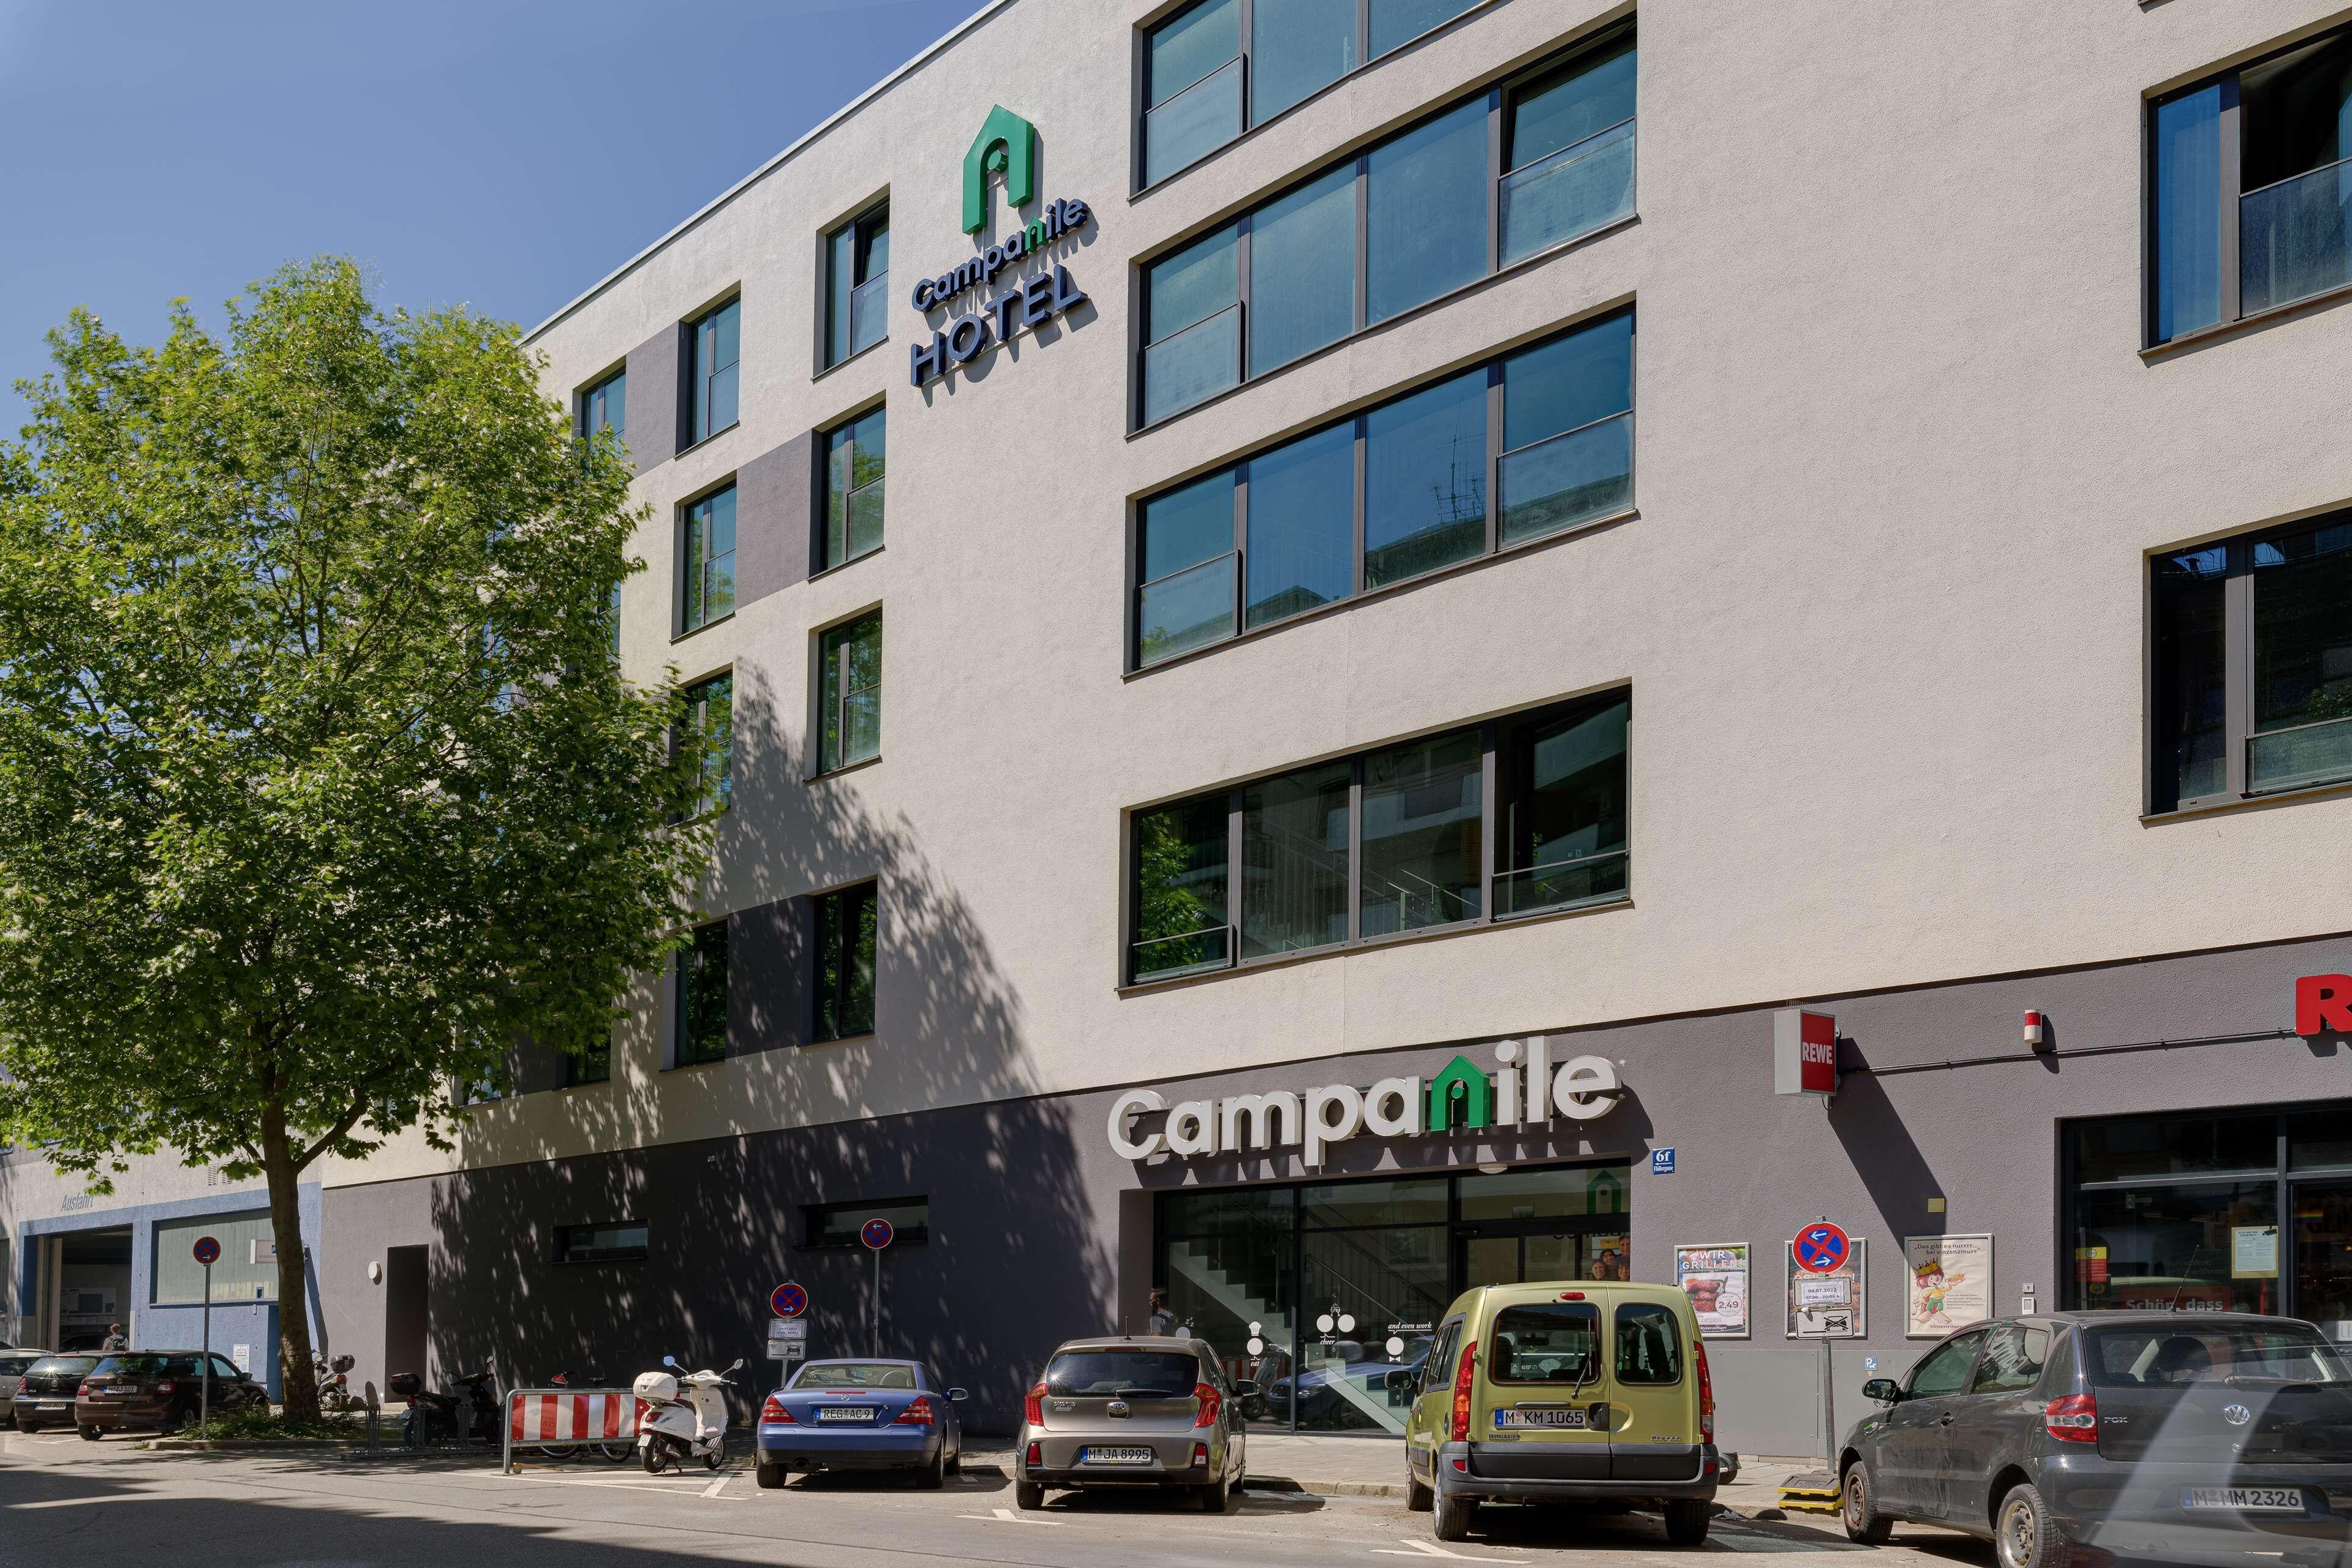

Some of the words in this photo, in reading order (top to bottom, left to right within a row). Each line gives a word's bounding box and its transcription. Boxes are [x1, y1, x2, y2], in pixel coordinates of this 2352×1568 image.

[912, 197, 1088, 312] Campanile
[911, 264, 1088, 387] HOTEL
[1802, 1042, 1833, 1065] REWE
[1107, 1035, 1622, 1167] Campanile
[1656, 1150, 1671, 1162] 6f
[1699, 1250, 1725, 1260] WIR
[1683, 1258, 1743, 1270] GRILLEN!
[2186, 1298, 2223, 1311] dass
[824, 1409, 843, 1419] REG
[850, 1409, 862, 1419] AC
[864, 1409, 870, 1419] 9
[1505, 1412, 1515, 1423] M
[1525, 1411, 1544, 1423] KM
[1547, 1411, 1583, 1424] 1065
[1088, 1449, 1096, 1459] M
[1104, 1449, 1118, 1459] JA
[1121, 1449, 1150, 1460] 8995
[2193, 1490, 2207, 1506] M
[2219, 1490, 2248, 1506] MM
[2250, 1491, 2298, 1506] 2326
